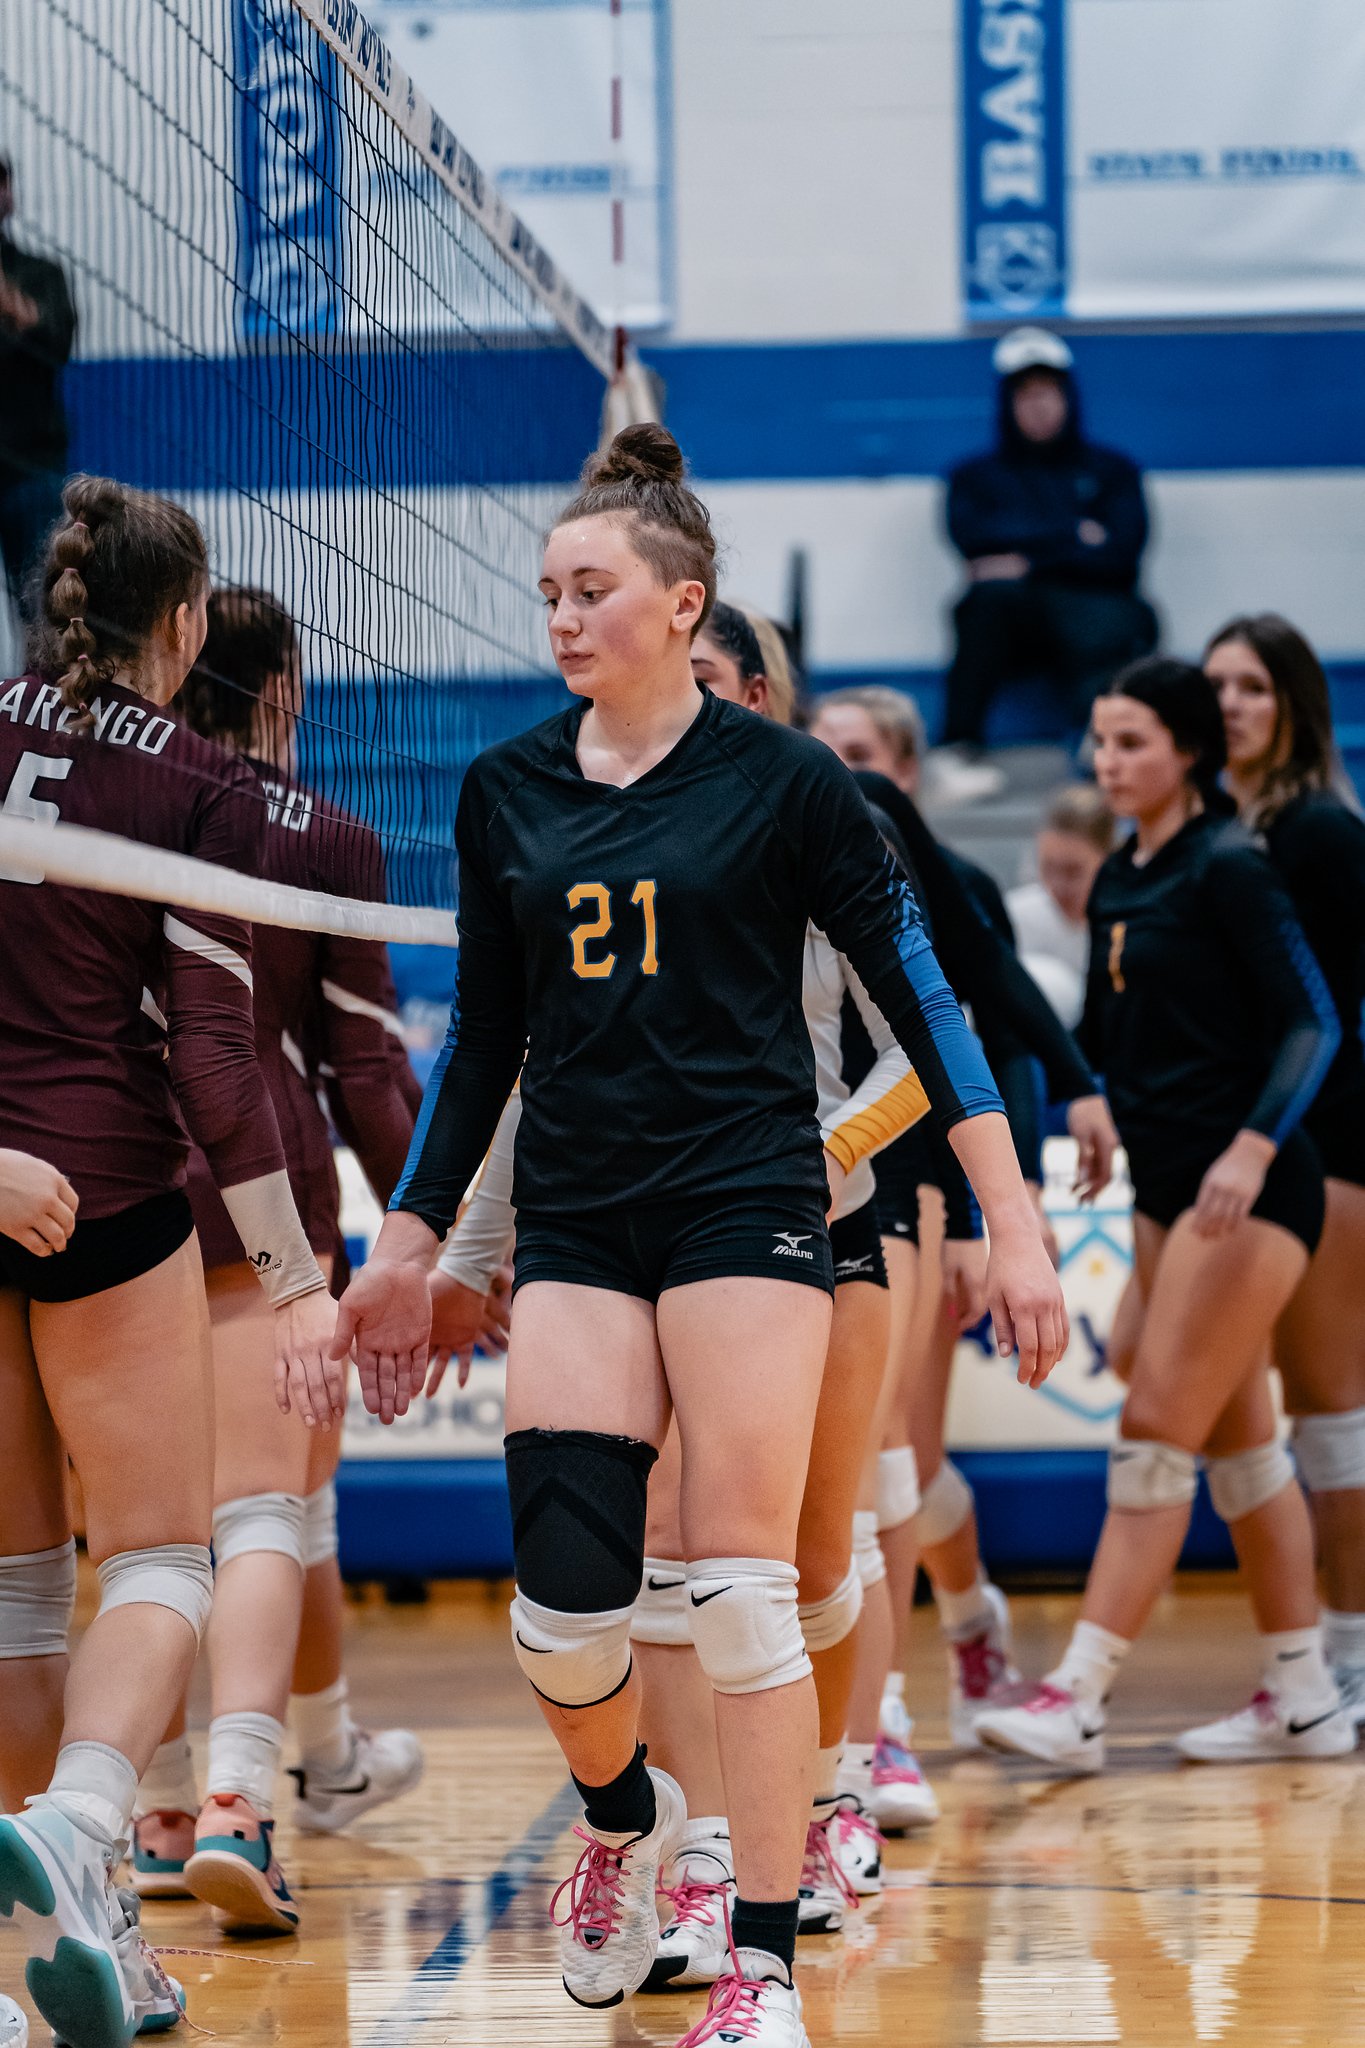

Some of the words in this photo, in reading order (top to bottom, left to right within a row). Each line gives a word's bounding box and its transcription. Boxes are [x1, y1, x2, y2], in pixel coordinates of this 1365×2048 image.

[979, 0, 1046, 208] BAS
[565, 879, 659, 980] 21
[772, 1245, 813, 1260] MIZUNO
